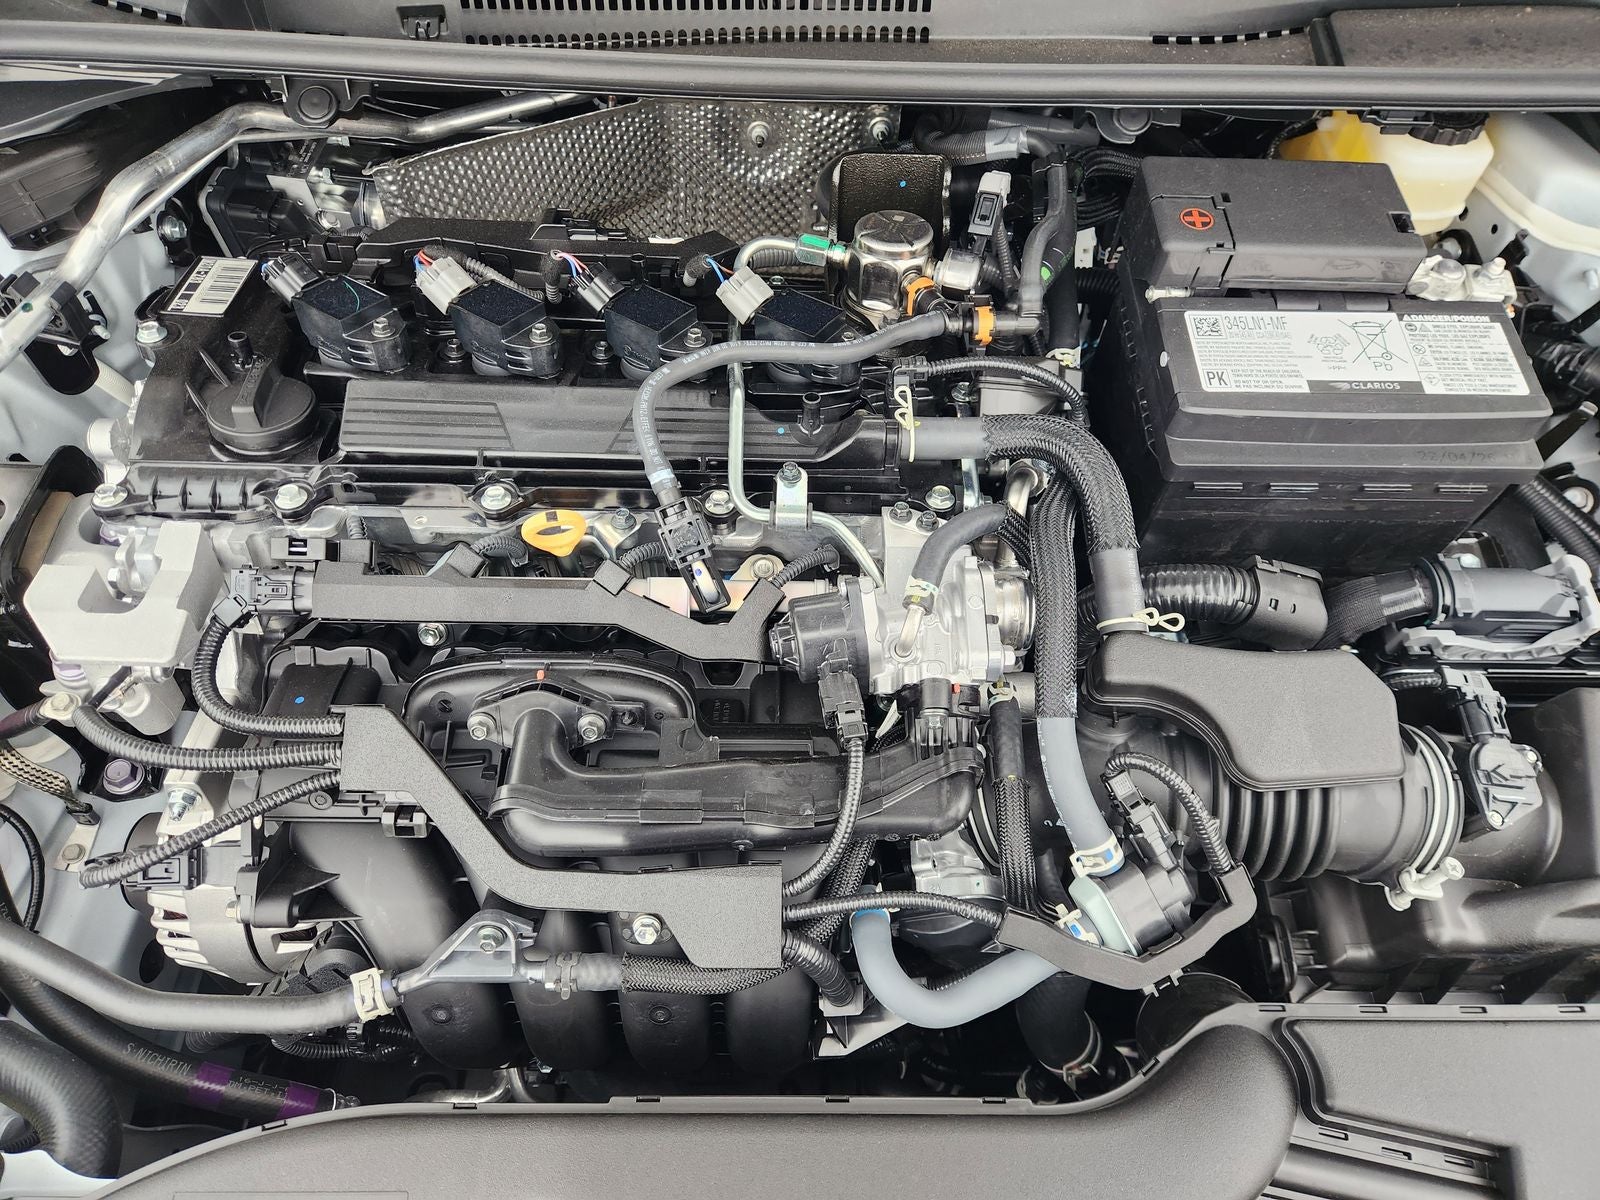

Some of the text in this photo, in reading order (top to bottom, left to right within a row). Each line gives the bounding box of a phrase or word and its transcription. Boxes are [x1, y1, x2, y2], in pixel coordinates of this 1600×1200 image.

[1224, 315, 1288, 331] 345LN1-MF
[1409, 314, 1491, 323] DANGER/POISON
[1373, 361, 1393, 371] Pb
[1206, 371, 1228, 386] PK
[1351, 382, 1401, 390] CLARIOS
